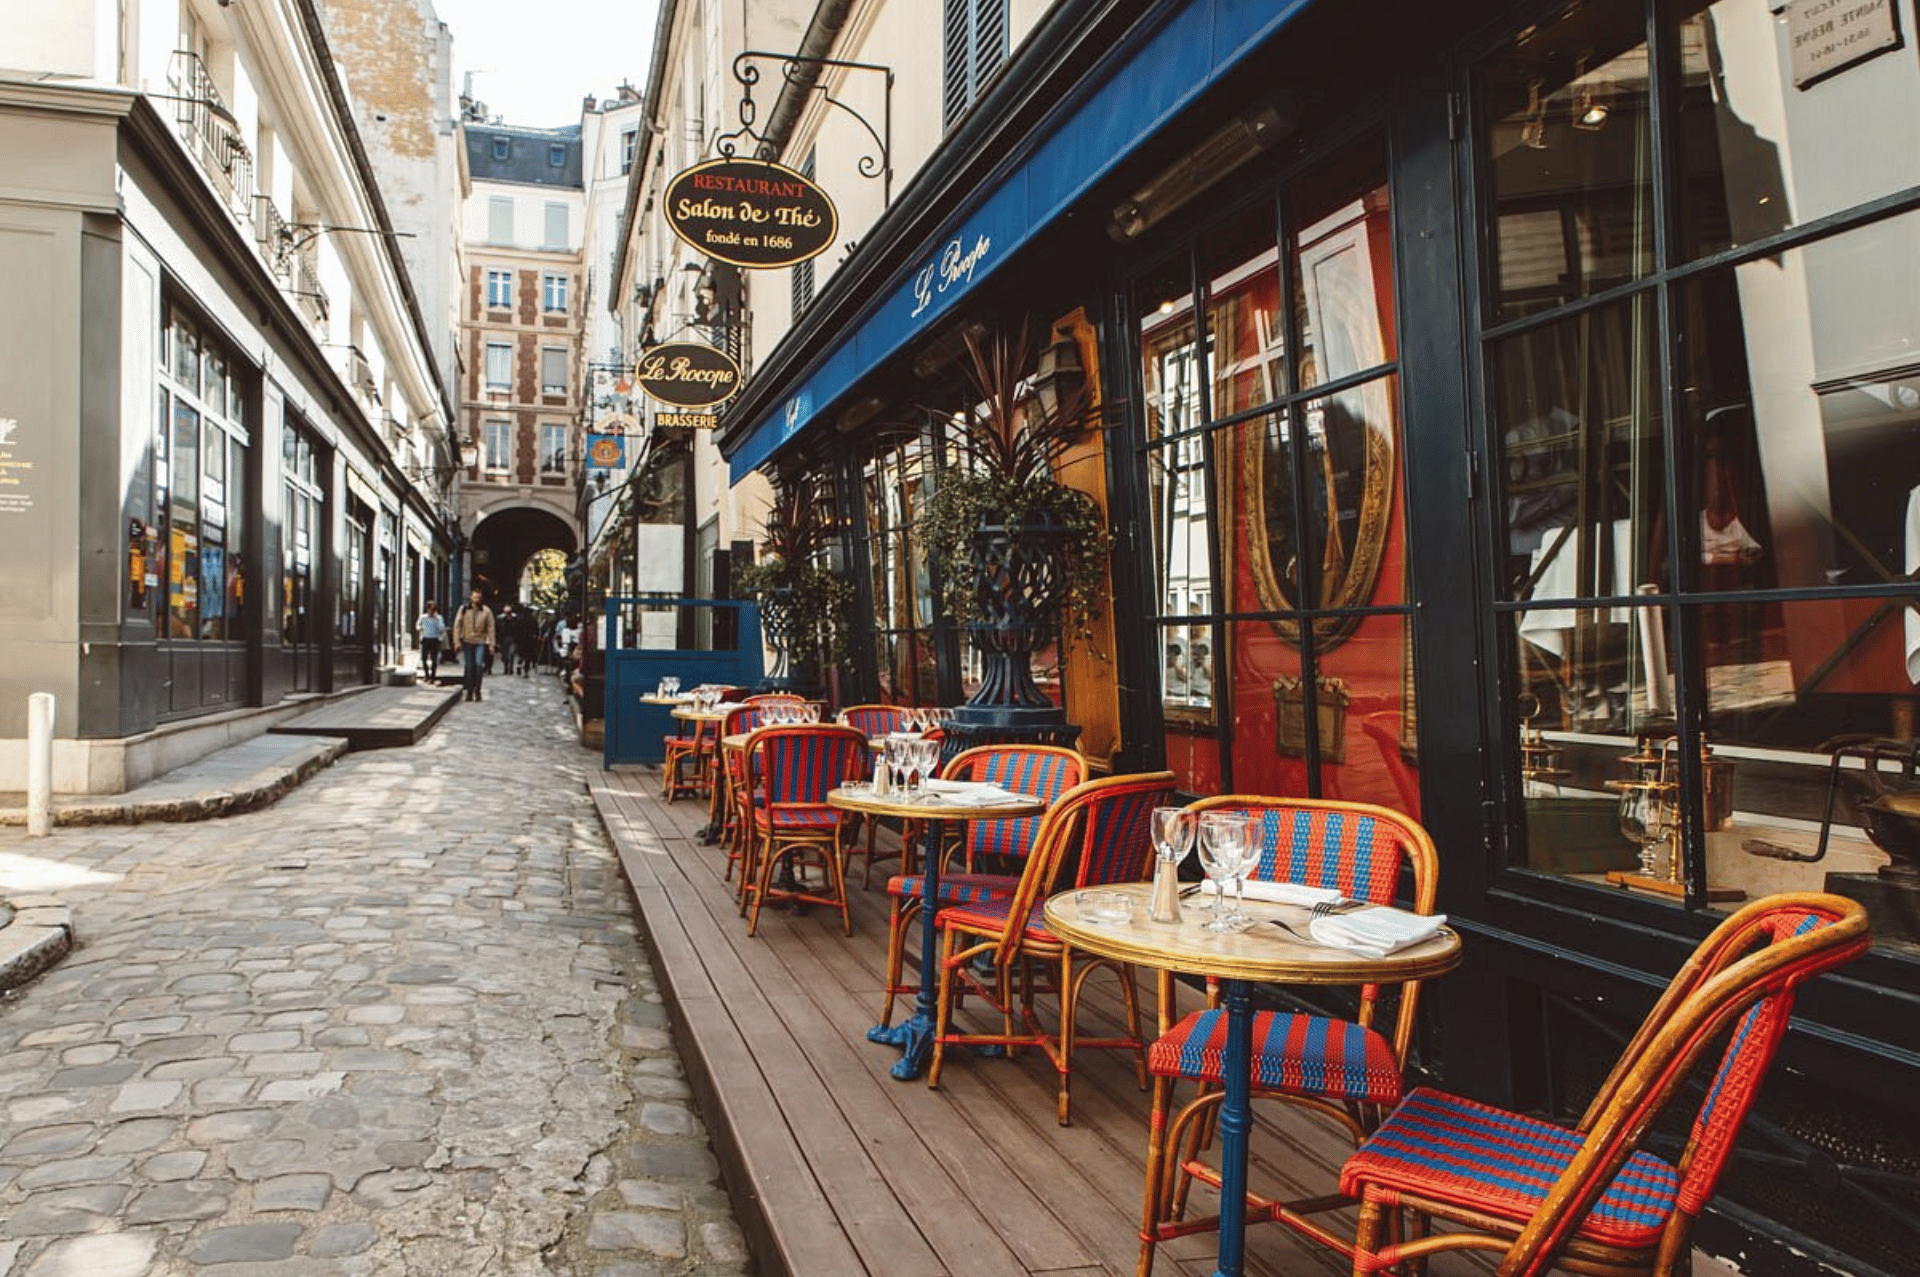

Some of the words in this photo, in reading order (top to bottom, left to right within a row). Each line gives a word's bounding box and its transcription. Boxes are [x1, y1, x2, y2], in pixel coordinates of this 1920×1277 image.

[693, 174, 807, 198] RESTAURANT
[676, 198, 735, 220] Salon
[739, 201, 770, 222] de
[774, 206, 821, 227] Thé
[705, 229, 740, 245] fondé
[743, 236, 759, 246] en
[763, 235, 793, 249] 1686
[910, 263, 935, 318] Le
[938, 234, 991, 292] Procope
[639, 356, 665, 380] Le
[665, 356, 734, 390] Procope
[657, 413, 717, 428] BRASSERIE
